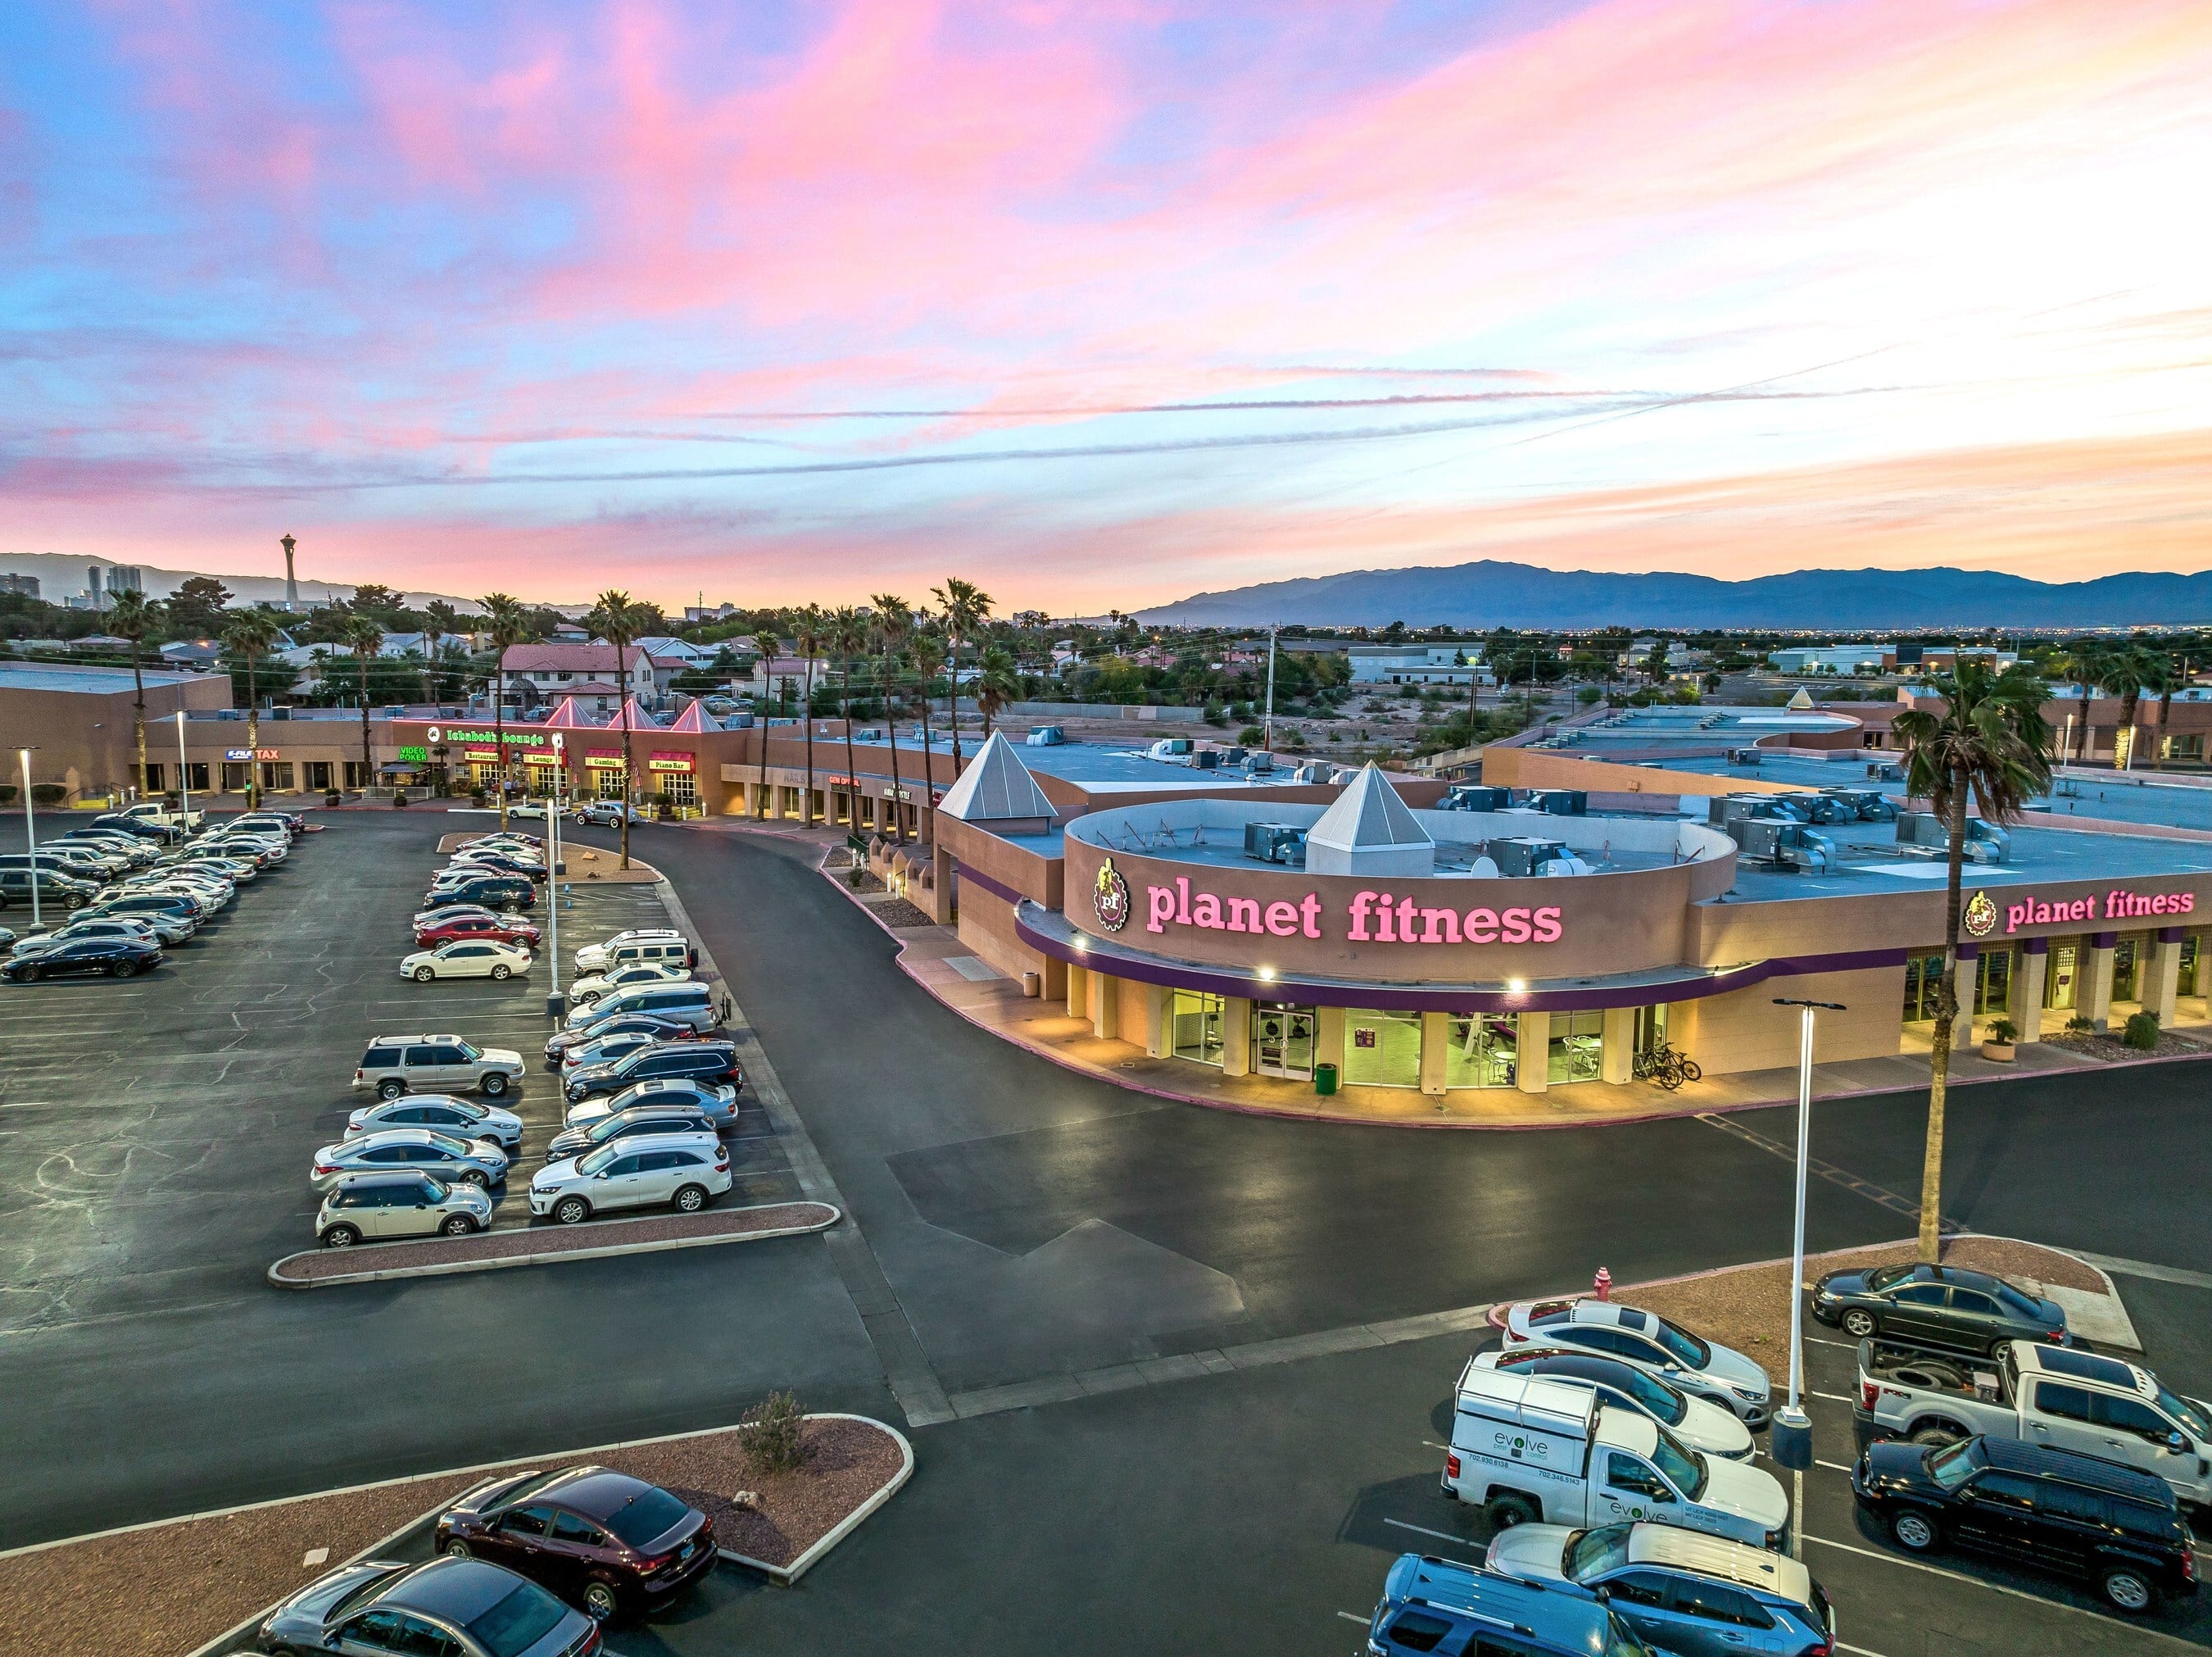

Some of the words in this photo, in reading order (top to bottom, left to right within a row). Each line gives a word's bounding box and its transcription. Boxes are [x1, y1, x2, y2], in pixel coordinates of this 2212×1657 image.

[446, 730, 497, 742] Ichabod's
[501, 733, 544, 747] Lounge
[255, 749, 279, 760] TAX
[399, 753, 427, 761] POKER
[469, 752, 498, 760] Restaurant
[1101, 892, 1120, 910] pf
[1147, 876, 1321, 938] planet
[1347, 891, 1562, 943] fitness
[1973, 910, 1990, 924] pf
[2006, 894, 2096, 933] planet
[2104, 890, 2195, 918] fitness
[1494, 1432, 1548, 1455] evolve
[1525, 1450, 1548, 1461] control
[1610, 1501, 1668, 1523] evolve
